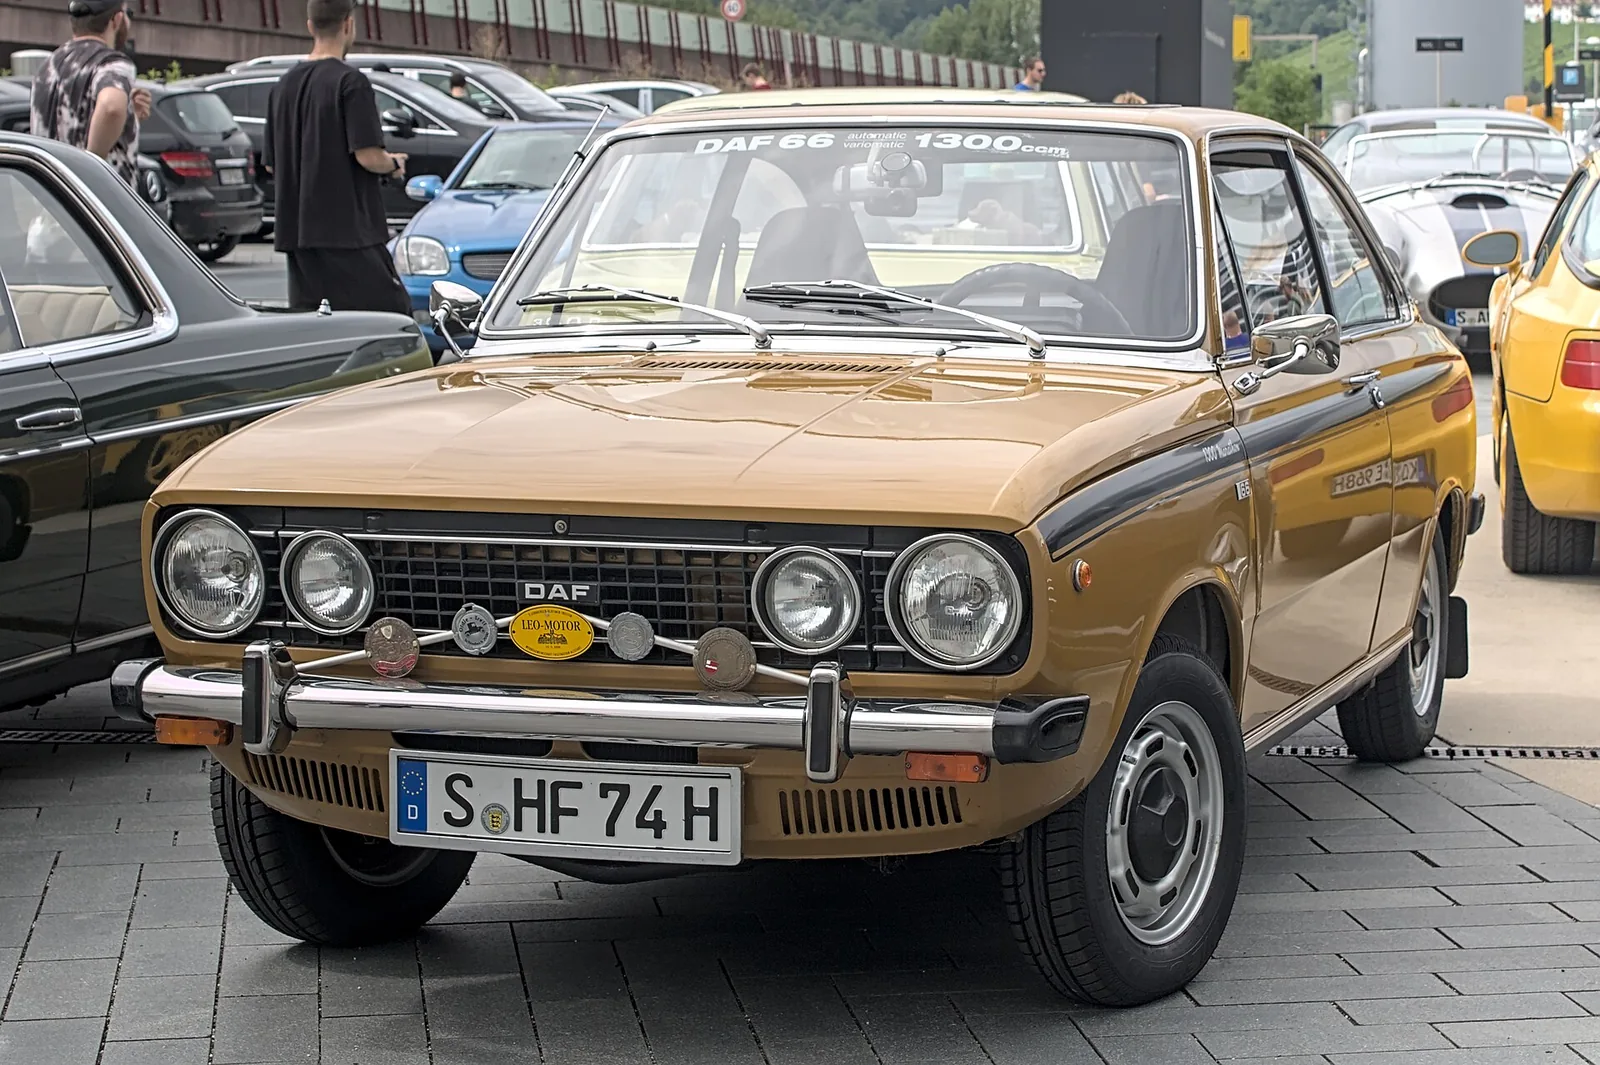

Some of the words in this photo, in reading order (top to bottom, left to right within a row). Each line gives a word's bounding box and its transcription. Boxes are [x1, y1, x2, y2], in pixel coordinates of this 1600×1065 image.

[847, 131, 907, 140] automatic
[694, 135, 775, 155] DAF
[778, 133, 835, 149] 66
[843, 140, 905, 149] variomatic
[1457, 311, 1466, 323] S
[1240, 481, 1250, 498] 66
[524, 583, 590, 600] DAF
[521, 619, 581, 631] LEO-MOTOR
[407, 804, 419, 820] D
[443, 773, 474, 828] S
[513, 777, 583, 834] HF
[599, 783, 667, 839] 74
[683, 786, 719, 842] H
